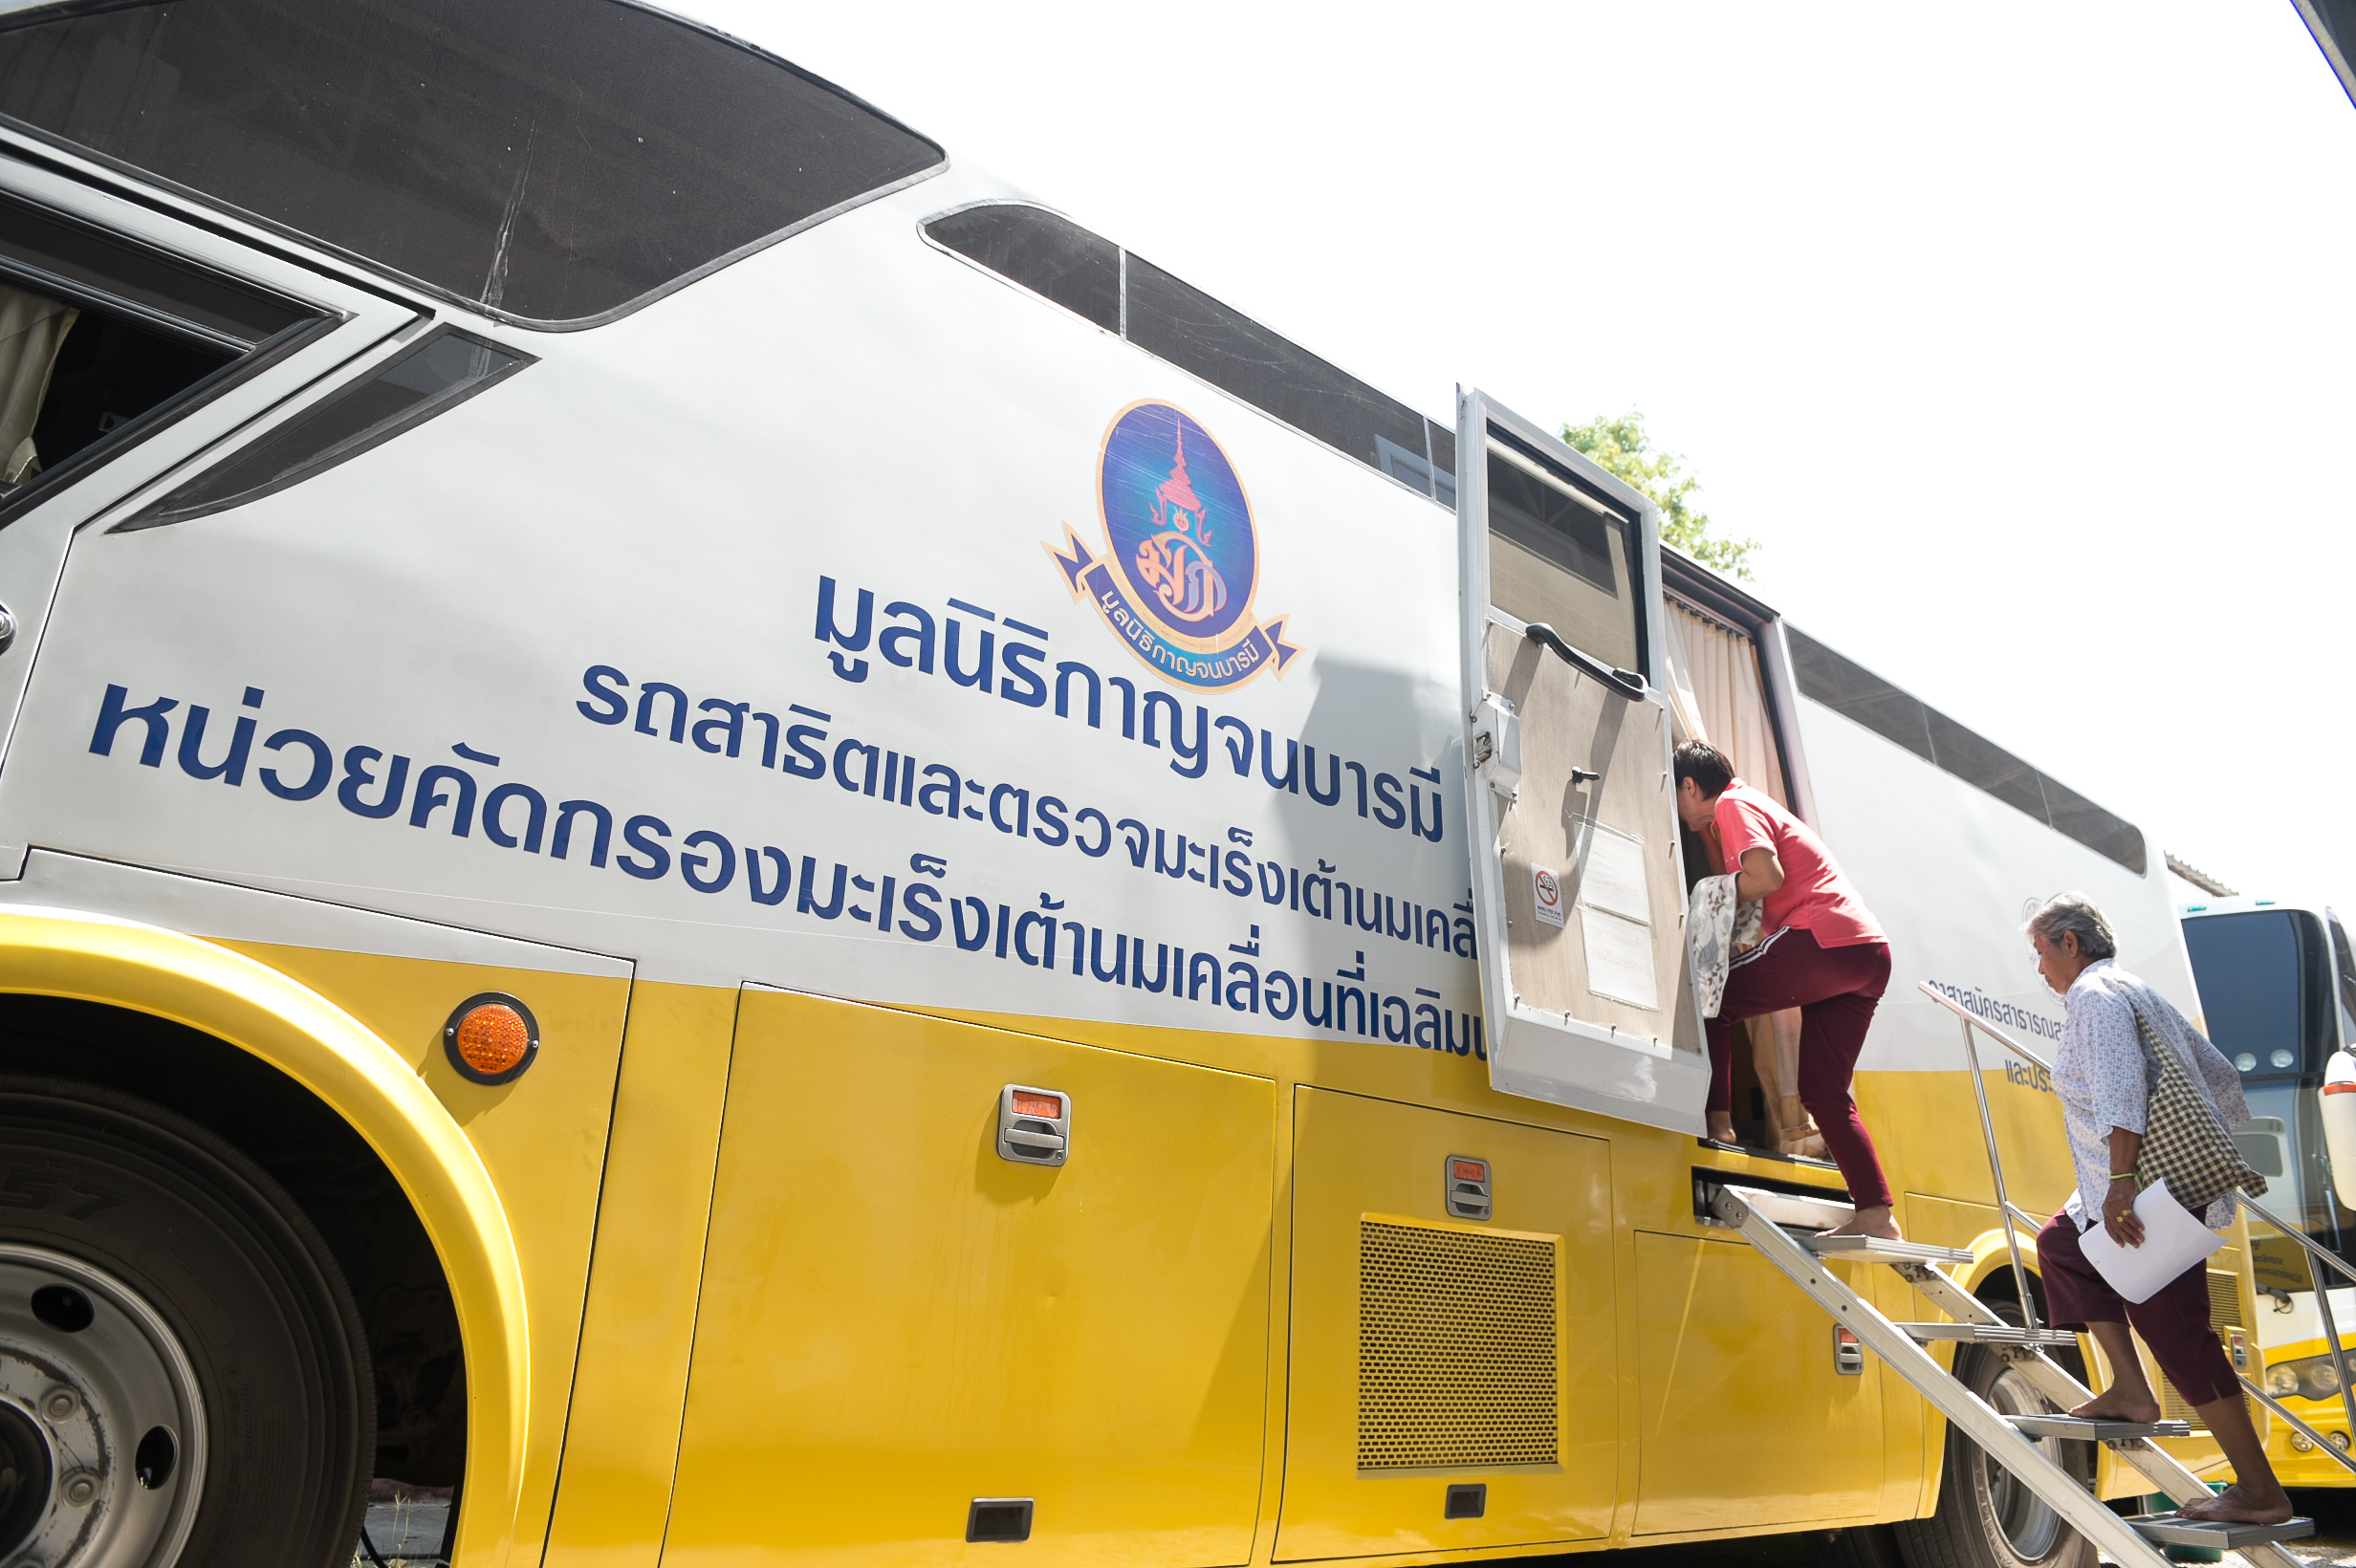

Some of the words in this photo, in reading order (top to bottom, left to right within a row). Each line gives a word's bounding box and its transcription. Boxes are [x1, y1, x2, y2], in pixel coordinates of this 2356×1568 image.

[815, 575, 1445, 843] มูลนิธิกาญจนบารมี
[1101, 589, 1260, 680] มูลนิธิกาญจนบารมี
